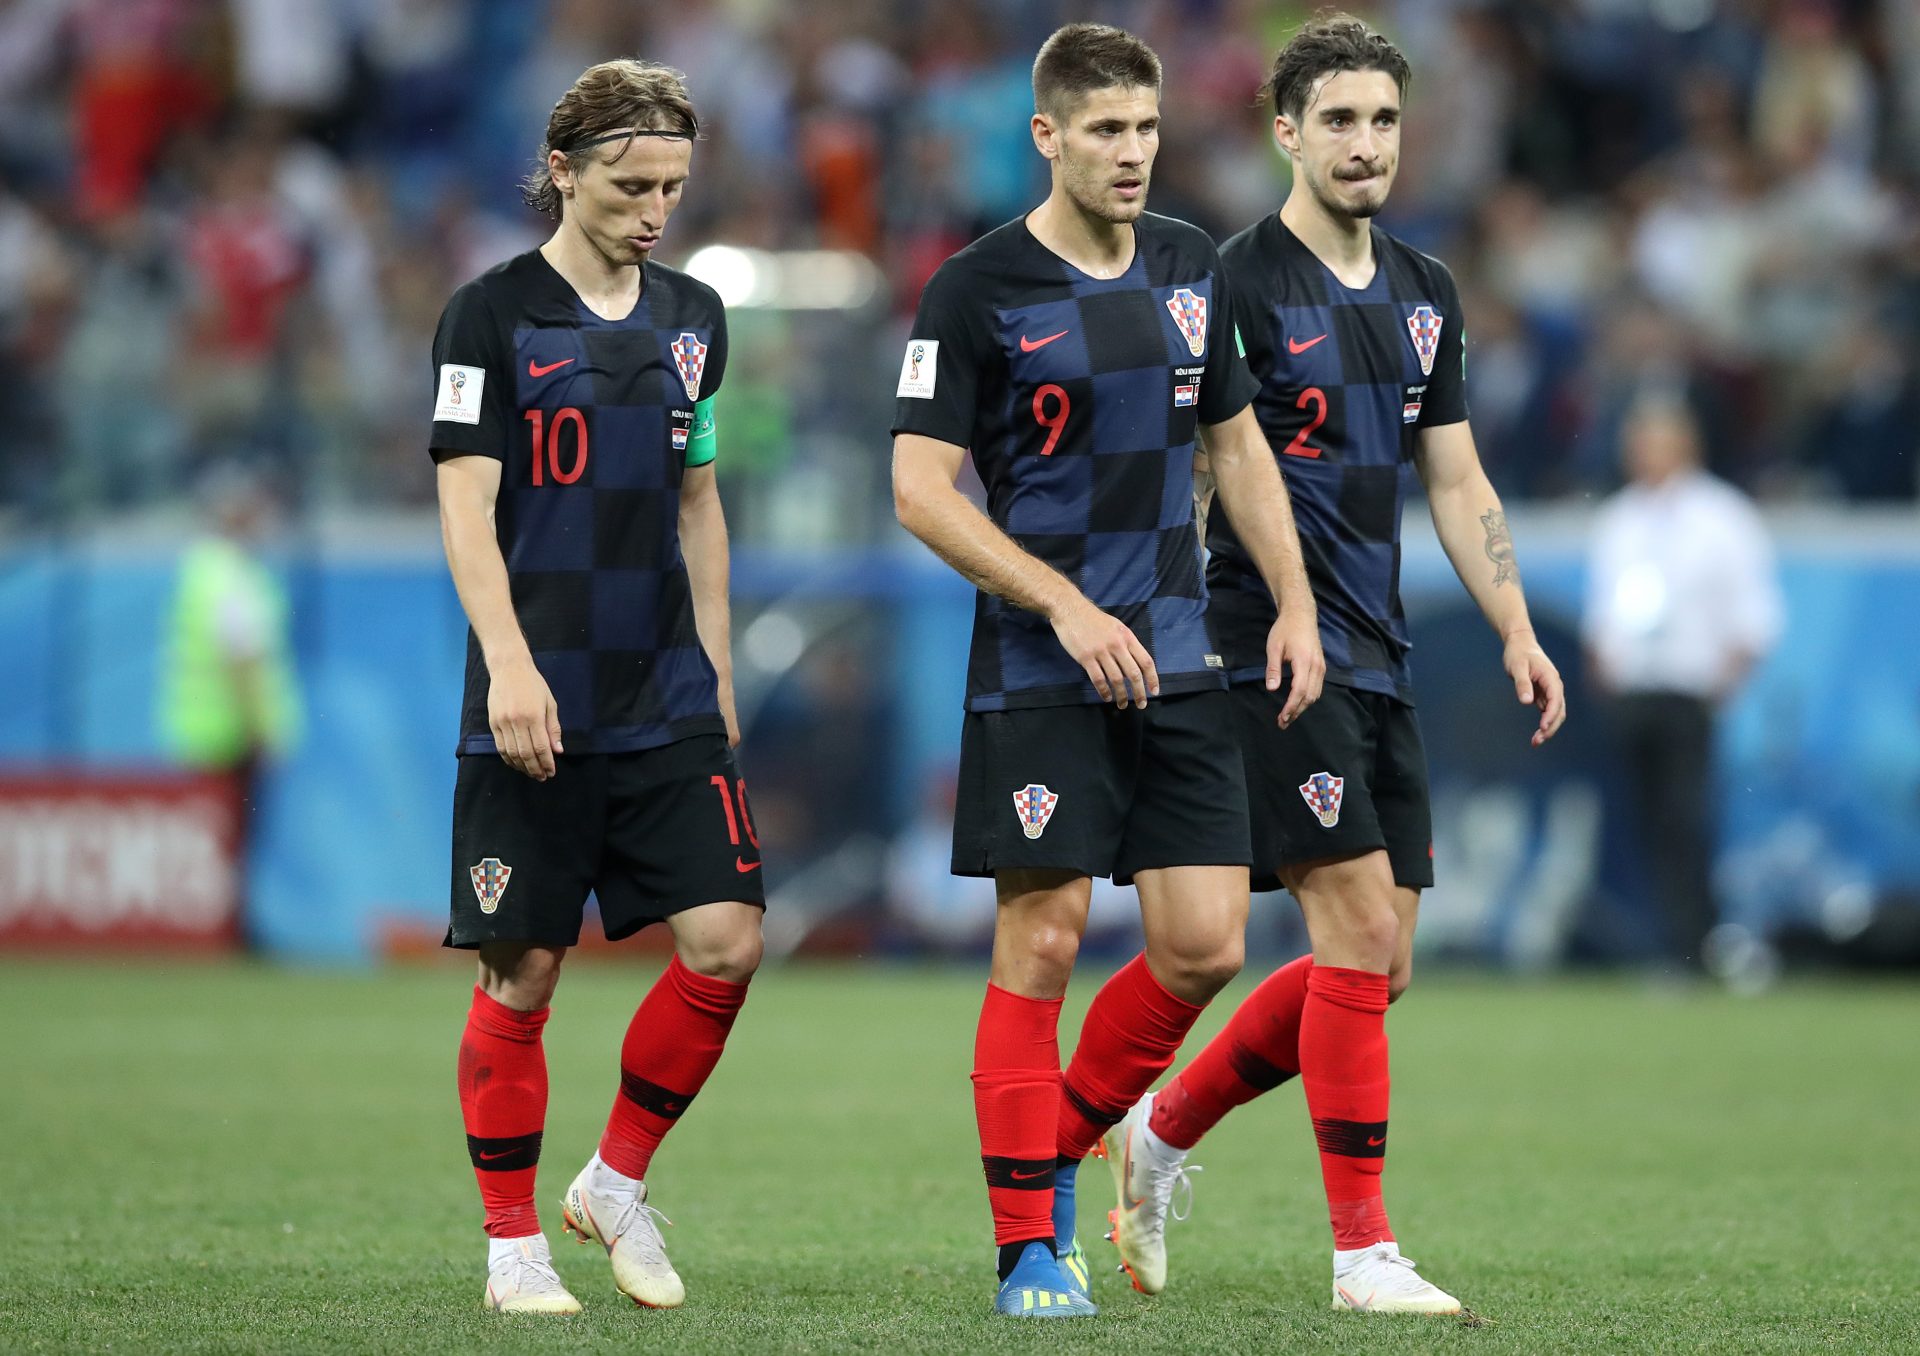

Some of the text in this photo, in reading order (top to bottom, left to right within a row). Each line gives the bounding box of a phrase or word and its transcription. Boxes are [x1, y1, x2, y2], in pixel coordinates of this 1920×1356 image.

[523, 407, 588, 486] 10
[1032, 384, 1071, 456] 9
[1282, 387, 1328, 459] 2
